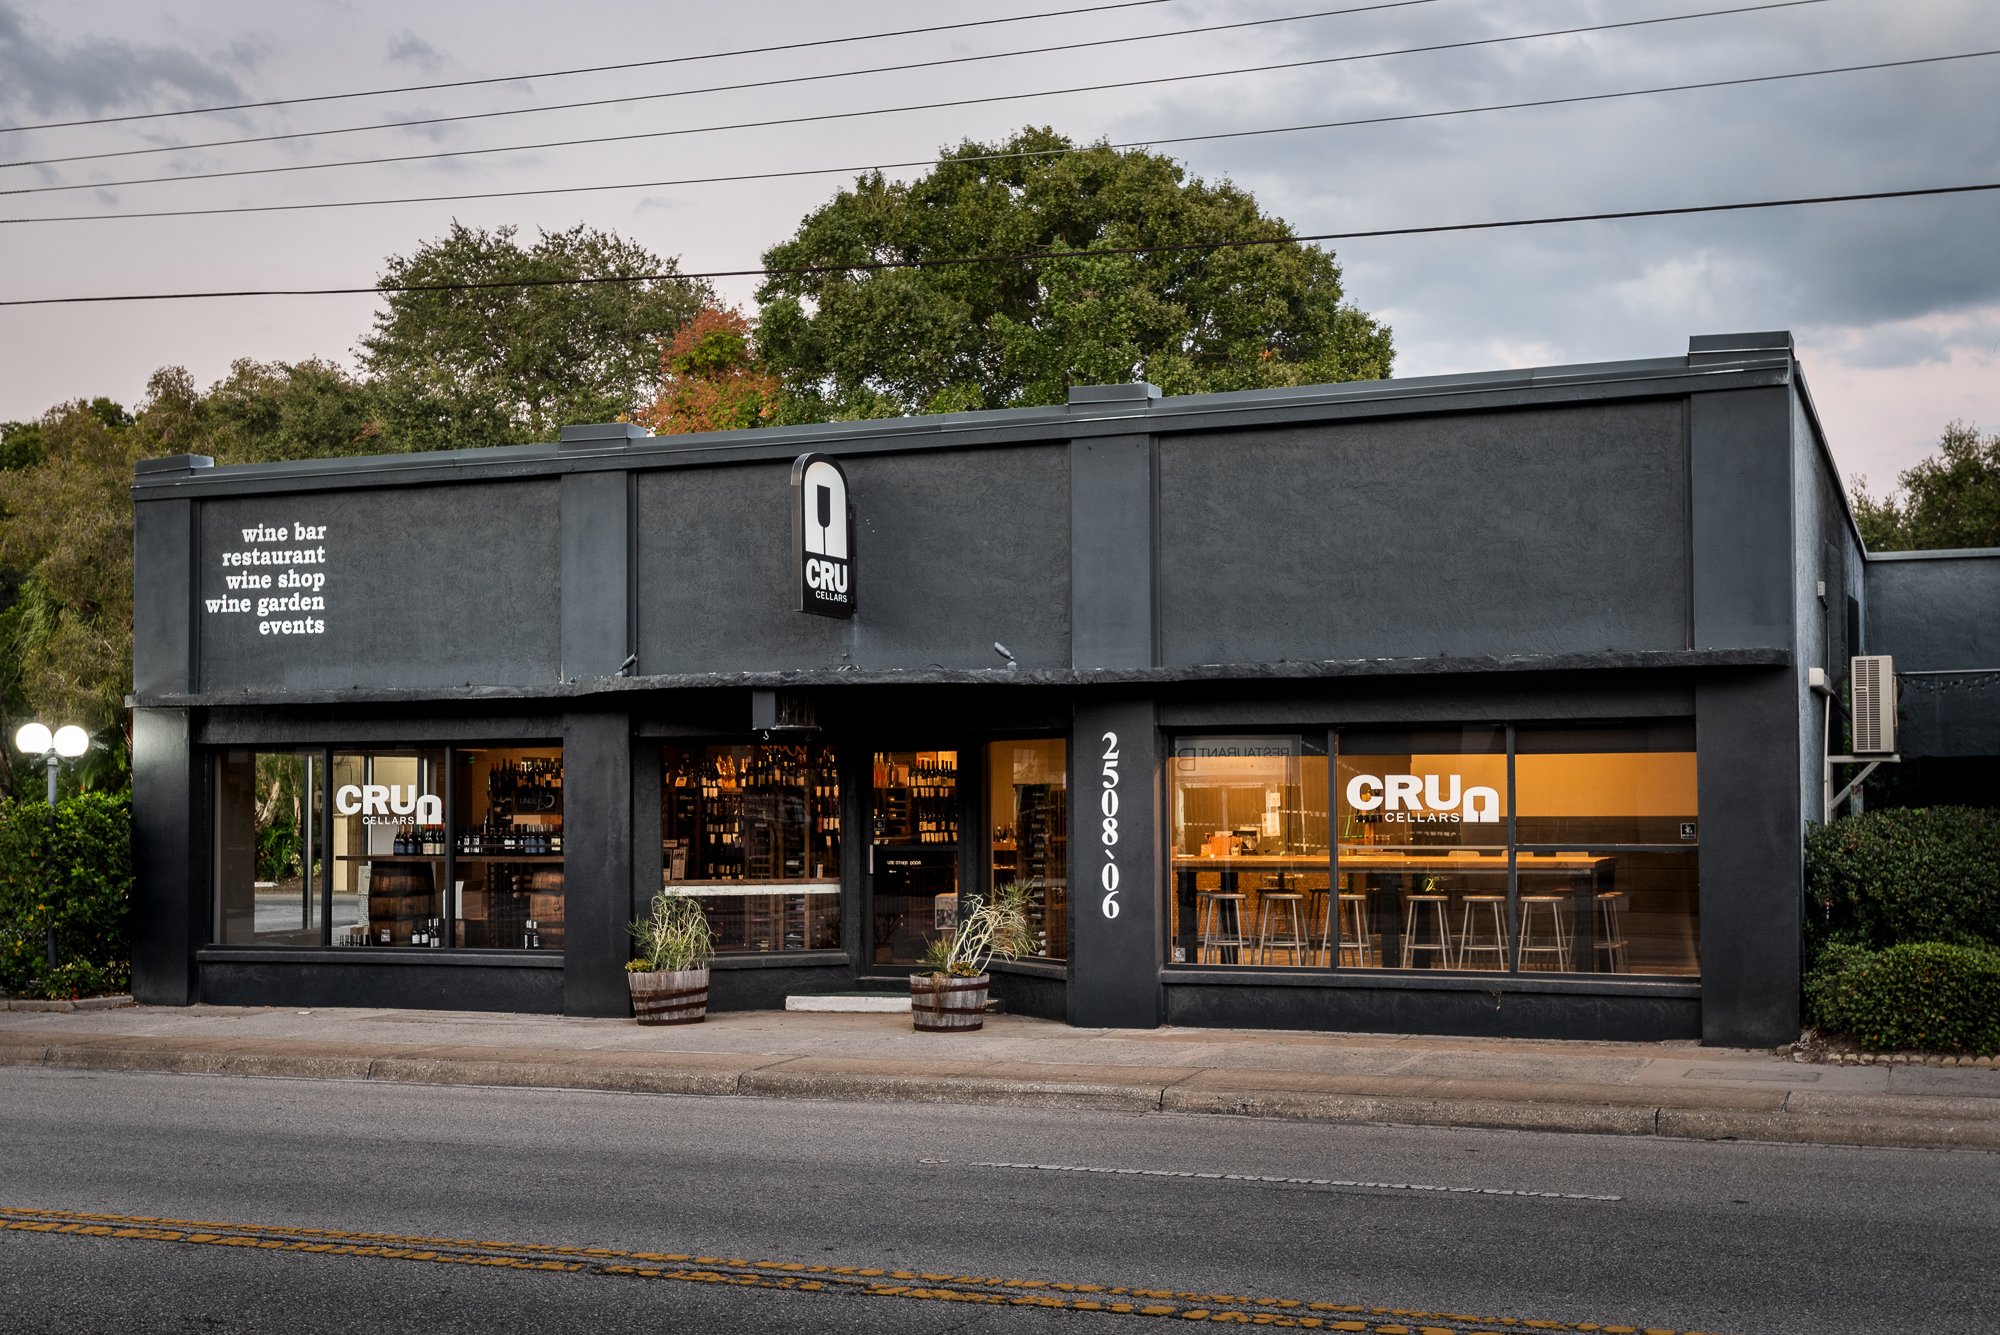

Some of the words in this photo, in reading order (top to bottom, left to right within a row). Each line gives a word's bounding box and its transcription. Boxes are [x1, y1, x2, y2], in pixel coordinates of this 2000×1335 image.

[242, 523, 288, 542] wine
[294, 522, 327, 541] bar
[222, 546, 326, 566] restaurant
[226, 570, 272, 589] wine
[278, 569, 325, 592] shop
[805, 558, 848, 593] CRU
[205, 594, 251, 613] wine
[257, 592, 325, 617] garden
[815, 590, 847, 603] CELLARS
[259, 616, 325, 635] events
[336, 784, 416, 815] CRU
[1346, 774, 1462, 811] CRU
[362, 816, 415, 825] CELLARS
[1384, 812, 1460, 823] CELLARS
